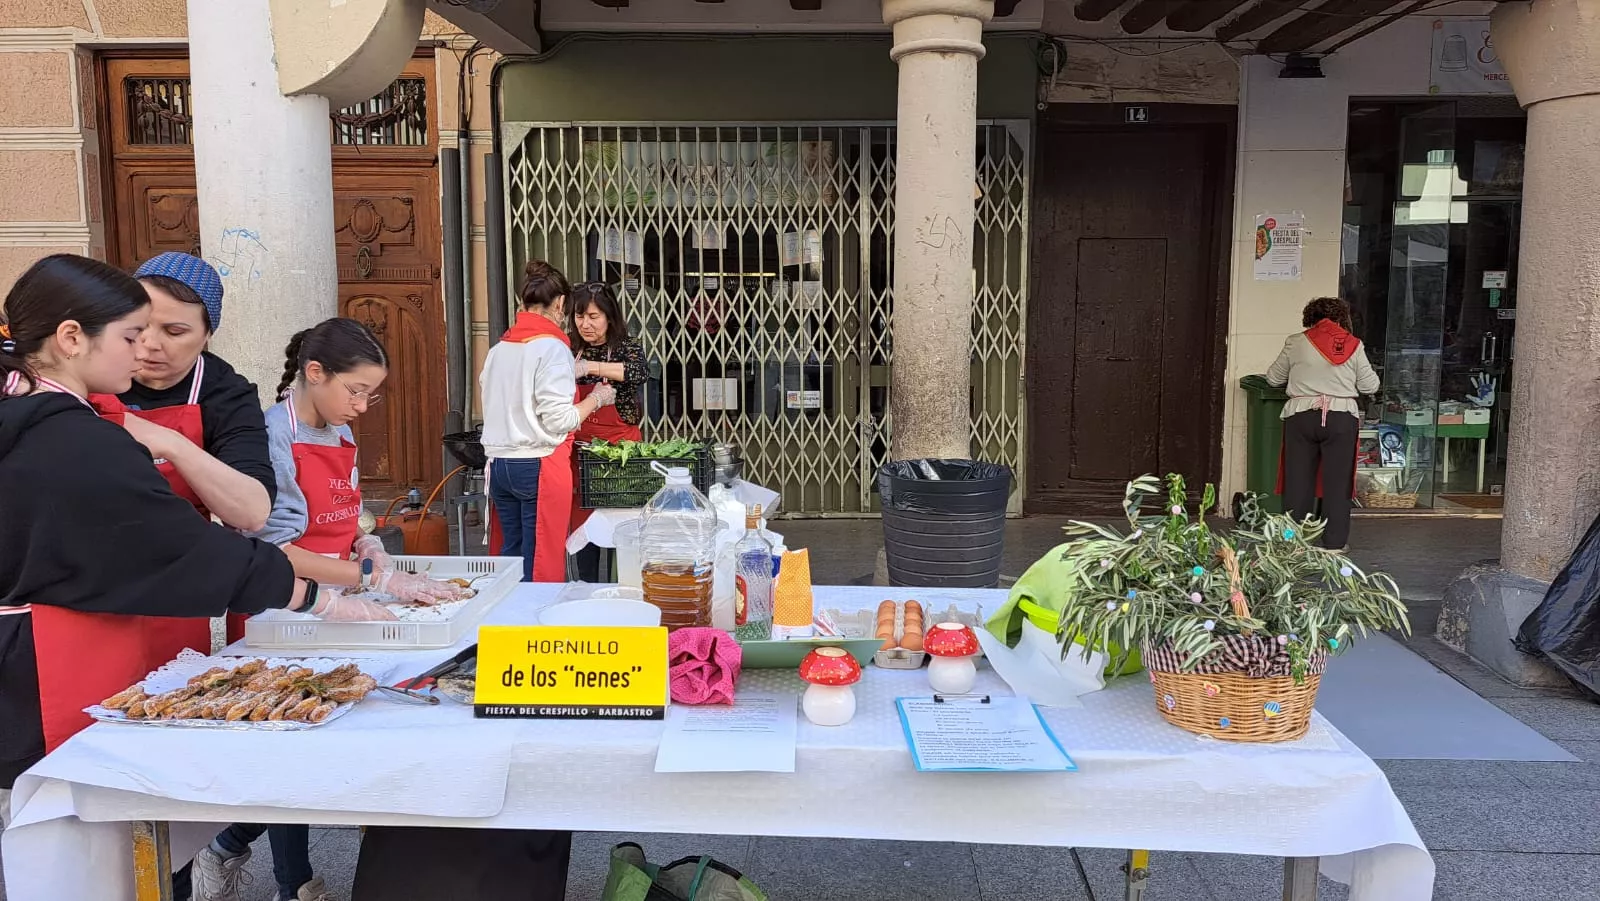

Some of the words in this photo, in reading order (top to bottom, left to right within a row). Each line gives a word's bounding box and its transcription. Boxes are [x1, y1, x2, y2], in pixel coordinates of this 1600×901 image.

[1483, 73, 1509, 81] MERCE
[1130, 108, 1145, 120] 14
[527, 639, 619, 655] HORNILLO
[502, 663, 524, 687] de
[531, 663, 557, 687] los
[485, 706, 516, 715] FIESTA
[520, 707, 536, 715] DEL
[540, 707, 588, 716] CRESPILLO
[599, 708, 653, 717] BARBASTRO
